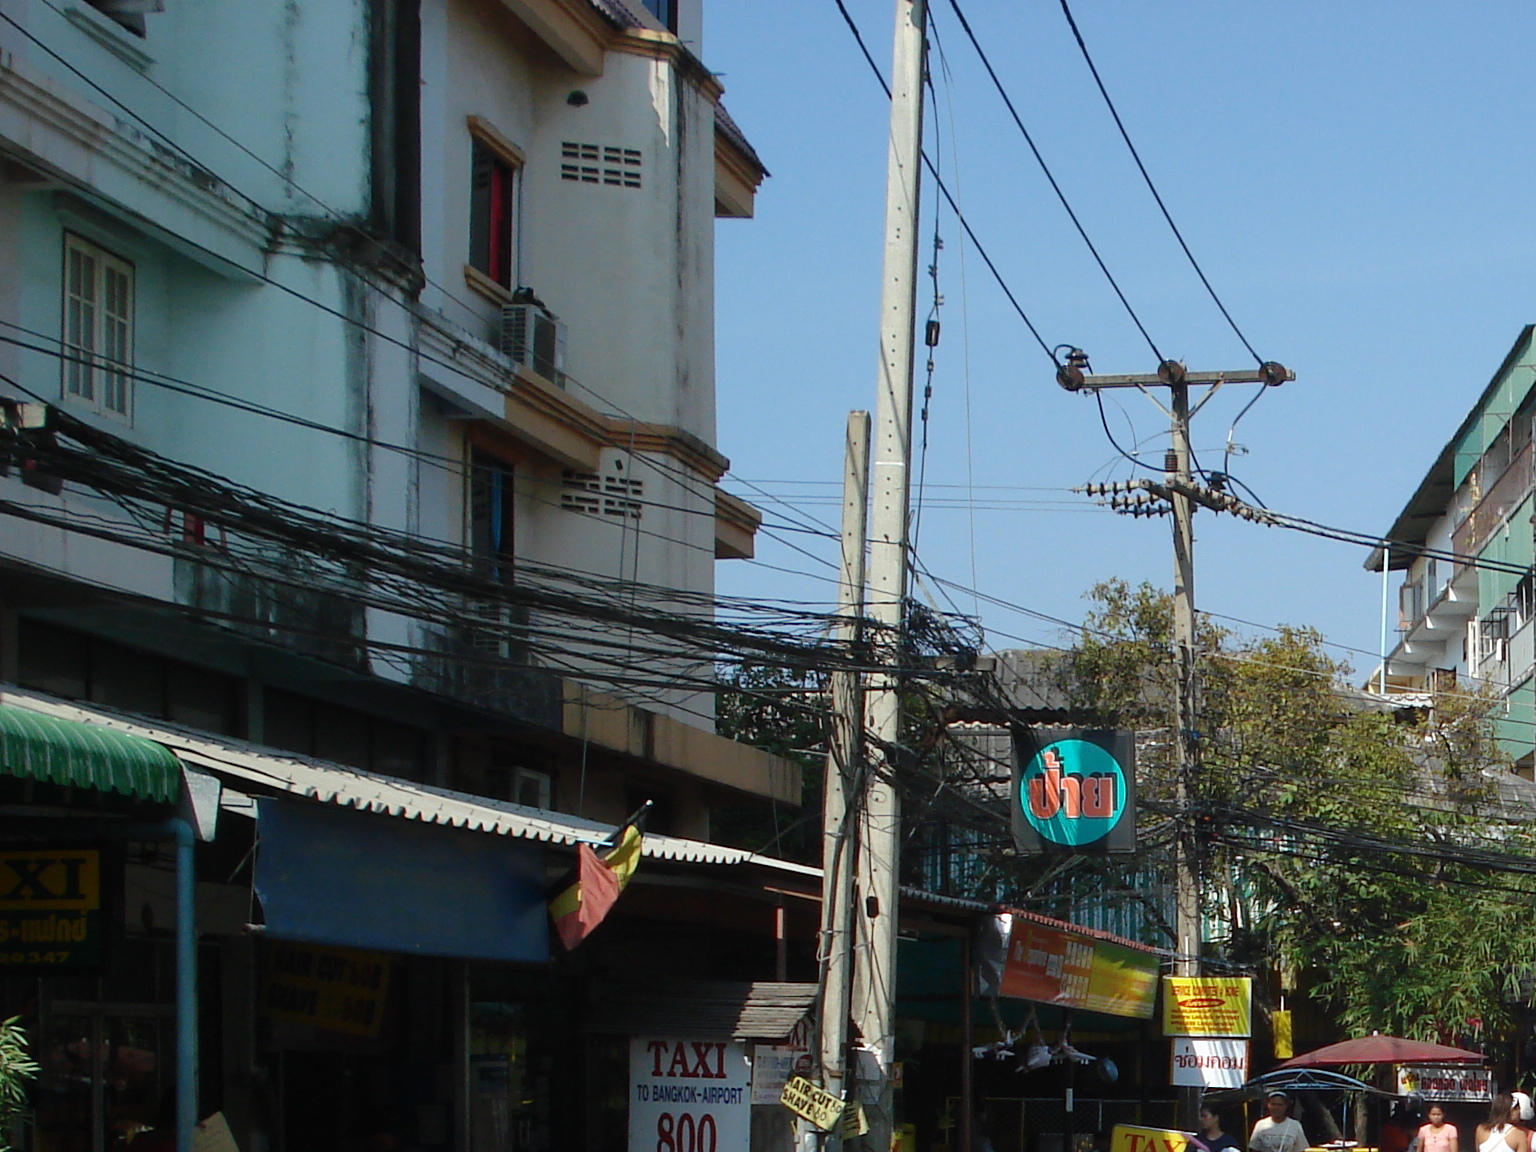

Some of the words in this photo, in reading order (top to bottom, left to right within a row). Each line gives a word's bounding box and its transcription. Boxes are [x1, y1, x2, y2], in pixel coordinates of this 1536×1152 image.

[647, 1040, 727, 1079] TAXI
[637, 1084, 649, 1101] TO
[653, 1085, 743, 1105] BANGKOK-AIRPORT
[783, 1088, 814, 1115] SHAVE
[812, 1091, 832, 1109] CUT
